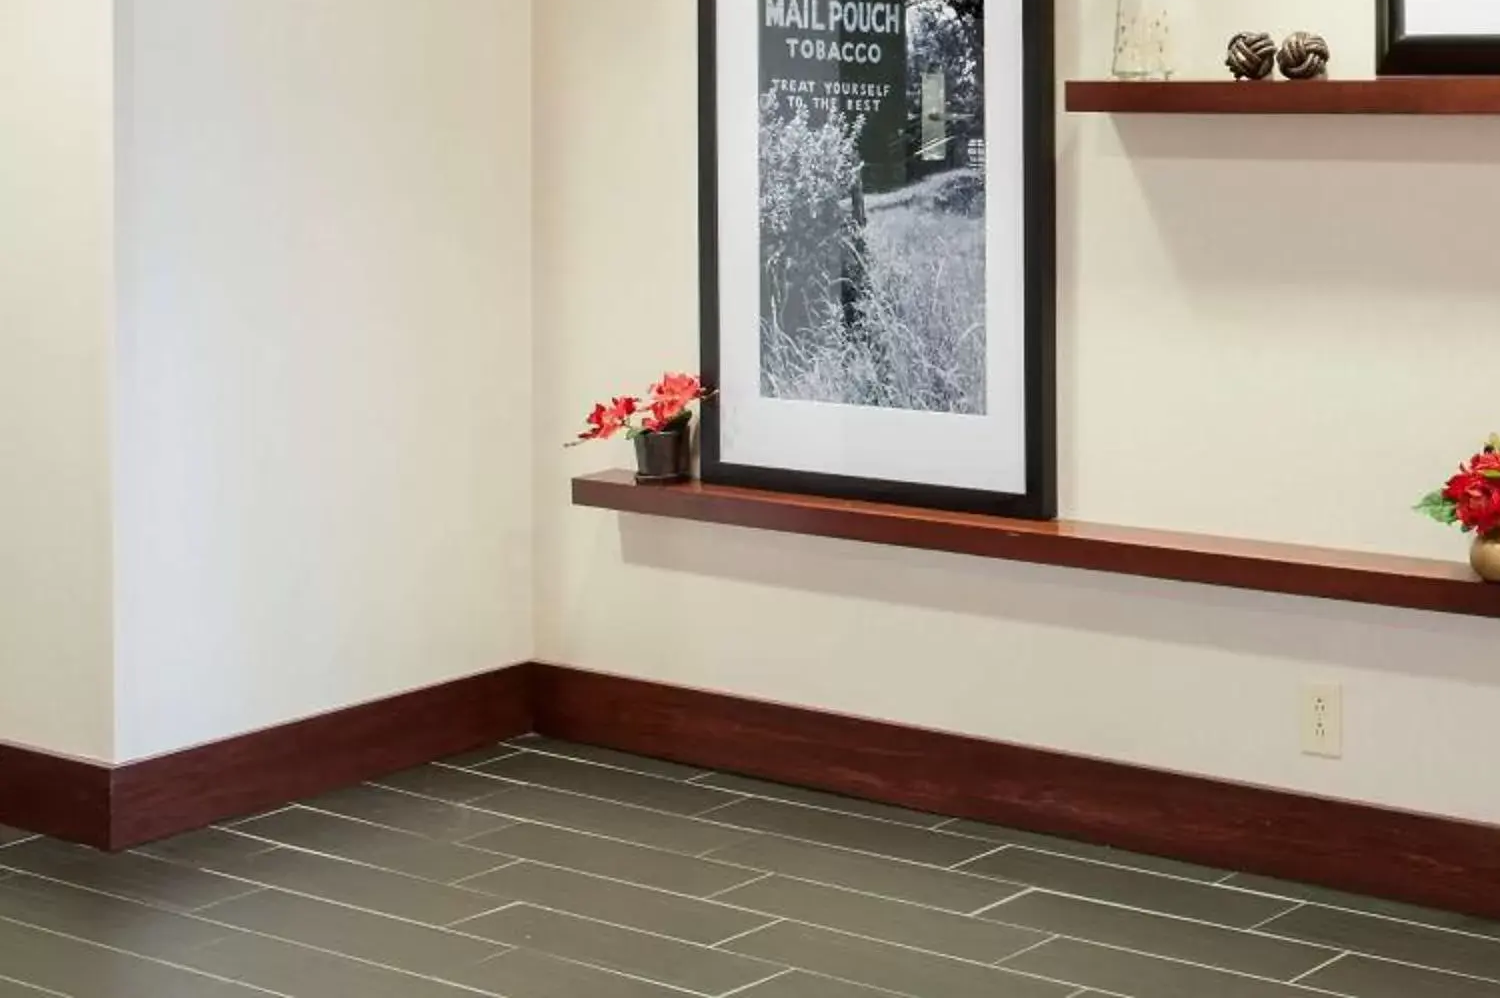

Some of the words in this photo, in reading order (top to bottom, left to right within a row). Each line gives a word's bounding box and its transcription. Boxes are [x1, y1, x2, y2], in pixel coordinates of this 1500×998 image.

[829, 0, 899, 34] POUCH
[785, 38, 882, 63] TOBACCO
[772, 78, 816, 93] TREAT
[824, 81, 891, 97] YOURSELF
[787, 95, 803, 109] TO
[812, 97, 838, 111] THE
[847, 99, 881, 112] BEST
